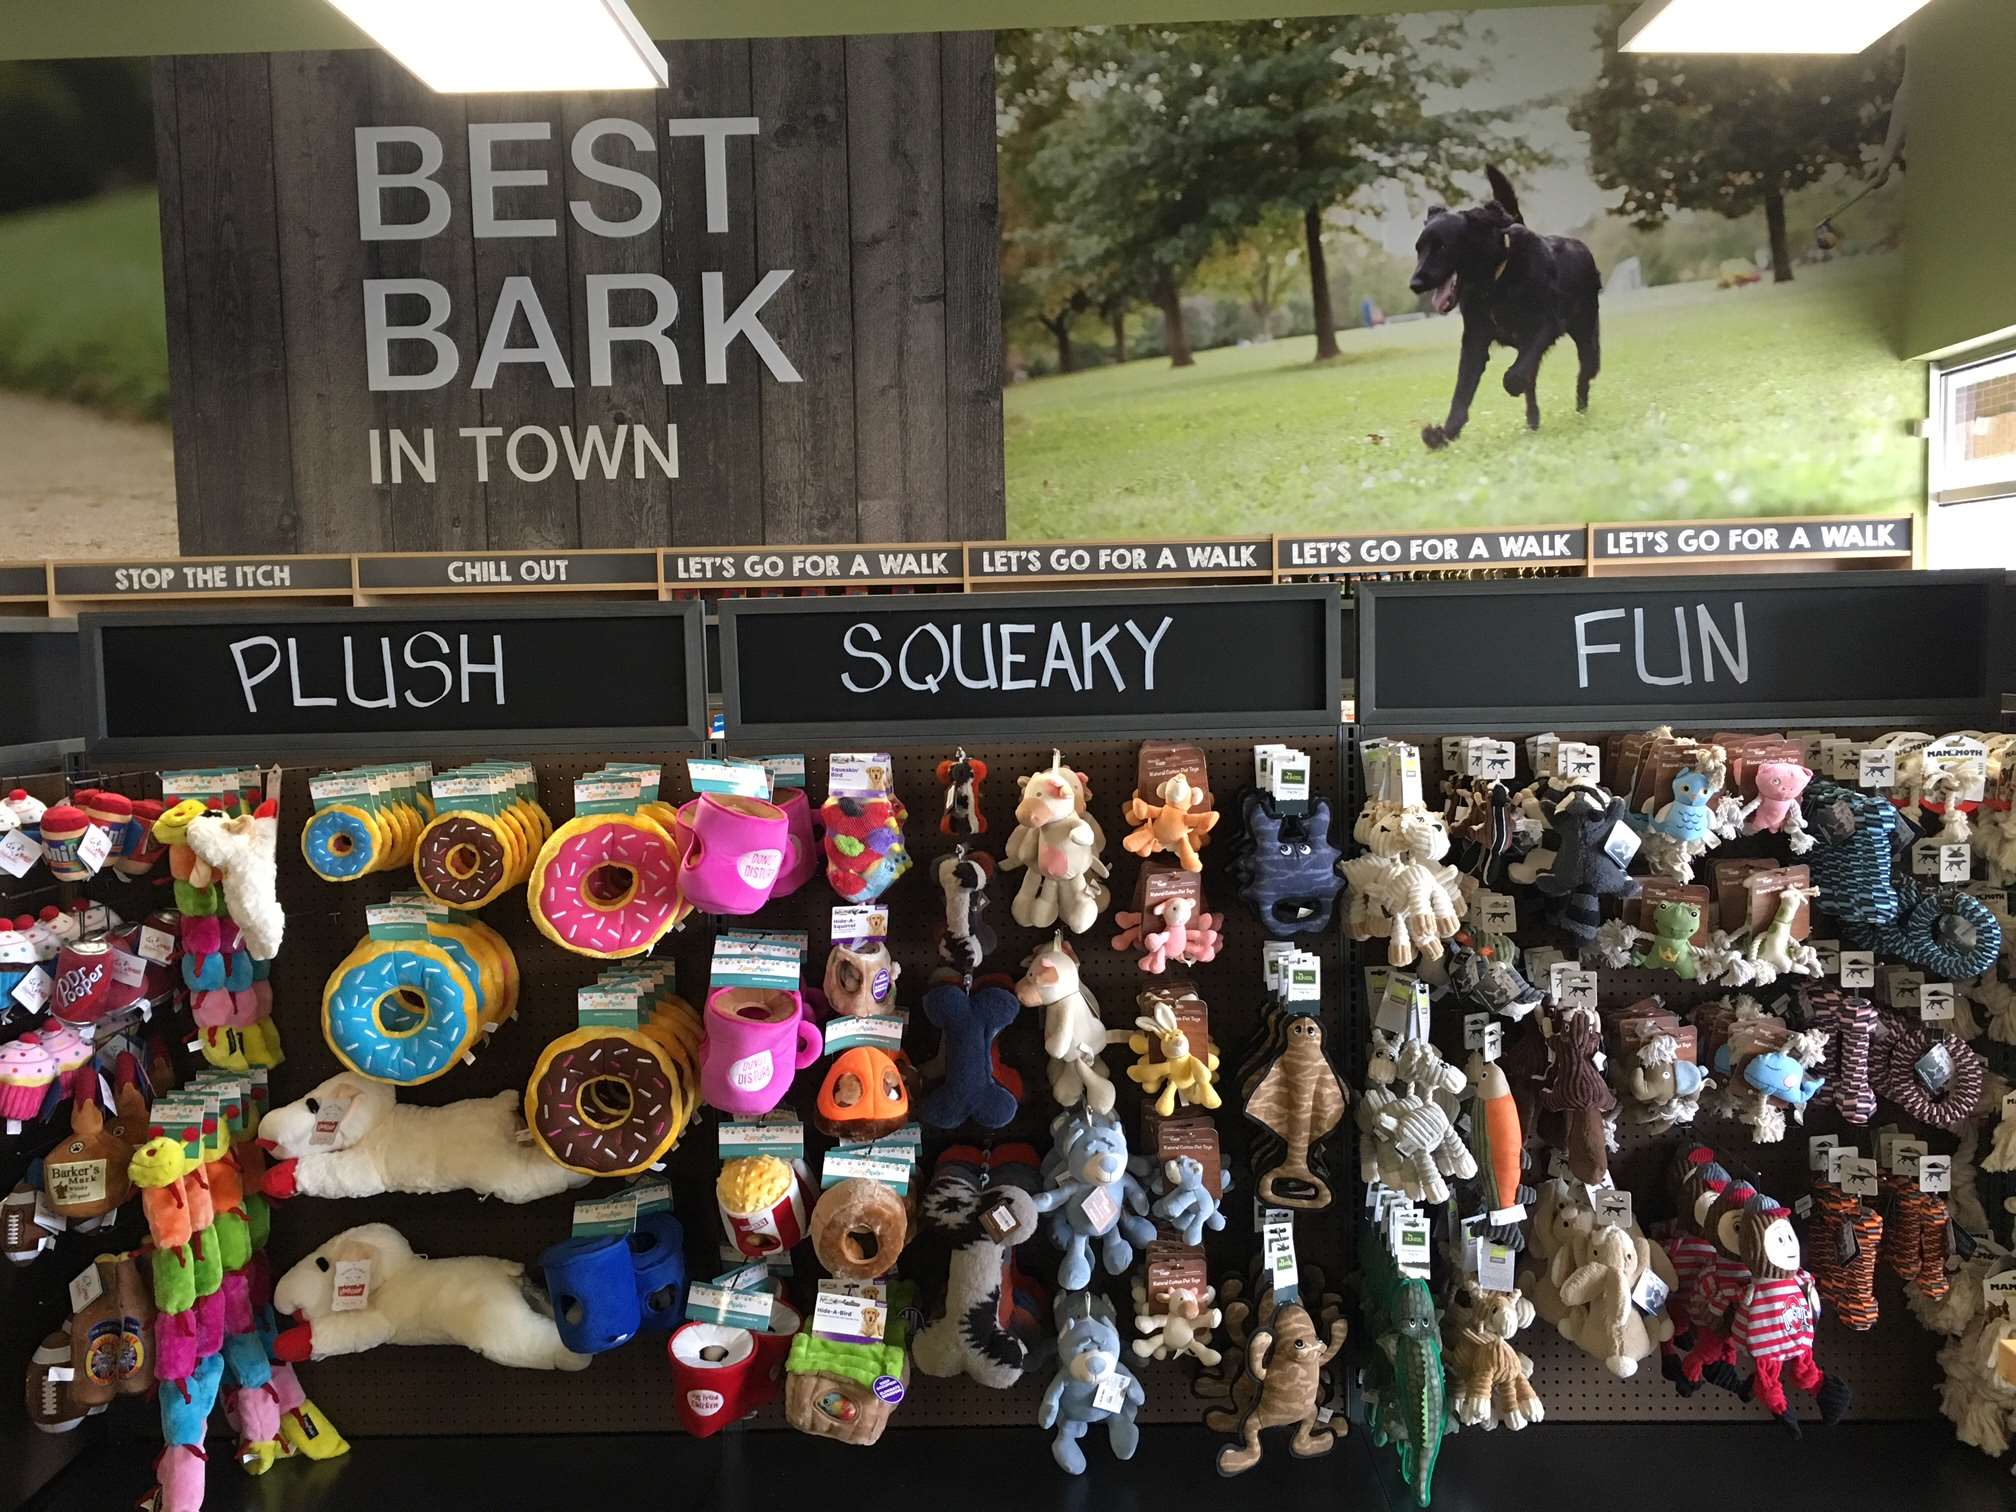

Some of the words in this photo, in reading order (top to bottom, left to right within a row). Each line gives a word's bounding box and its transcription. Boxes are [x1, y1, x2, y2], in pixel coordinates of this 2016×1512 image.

[354, 116, 760, 241] BEST
[362, 269, 805, 392] BARK
[369, 428, 437, 485] IN
[458, 423, 680, 483] TOWN
[1291, 541, 1352, 567] LET'S
[1360, 539, 1402, 563] GO
[1409, 537, 1459, 562] FOR
[1467, 536, 1490, 560] A
[1498, 533, 1572, 559] WALK
[1606, 532, 1668, 556] LET'S
[1677, 530, 1719, 554] GO
[1729, 528, 1778, 553] FOR
[1788, 527, 1811, 550] A
[1822, 524, 1896, 549] WALK
[447, 561, 513, 583] CHILL
[520, 559, 570, 582] OUT
[677, 556, 736, 579] LET'S
[744, 555, 785, 577] GO
[792, 555, 840, 577] FOR
[849, 553, 870, 575] A
[879, 552, 950, 575] WALK
[982, 550, 1041, 573] LET'S
[1049, 549, 1090, 571] GO
[1099, 547, 1148, 570] FOR
[1156, 546, 1177, 569] A
[1185, 544, 1258, 568] WALK
[114, 567, 176, 591] STOP
[182, 566, 228, 589] THE
[234, 564, 292, 588] ITCH
[840, 615, 1174, 694] SQUEAKY
[1574, 601, 1749, 689] FUN
[229, 631, 505, 713] PLUSH
[51, 1164, 100, 1179] Barker's
